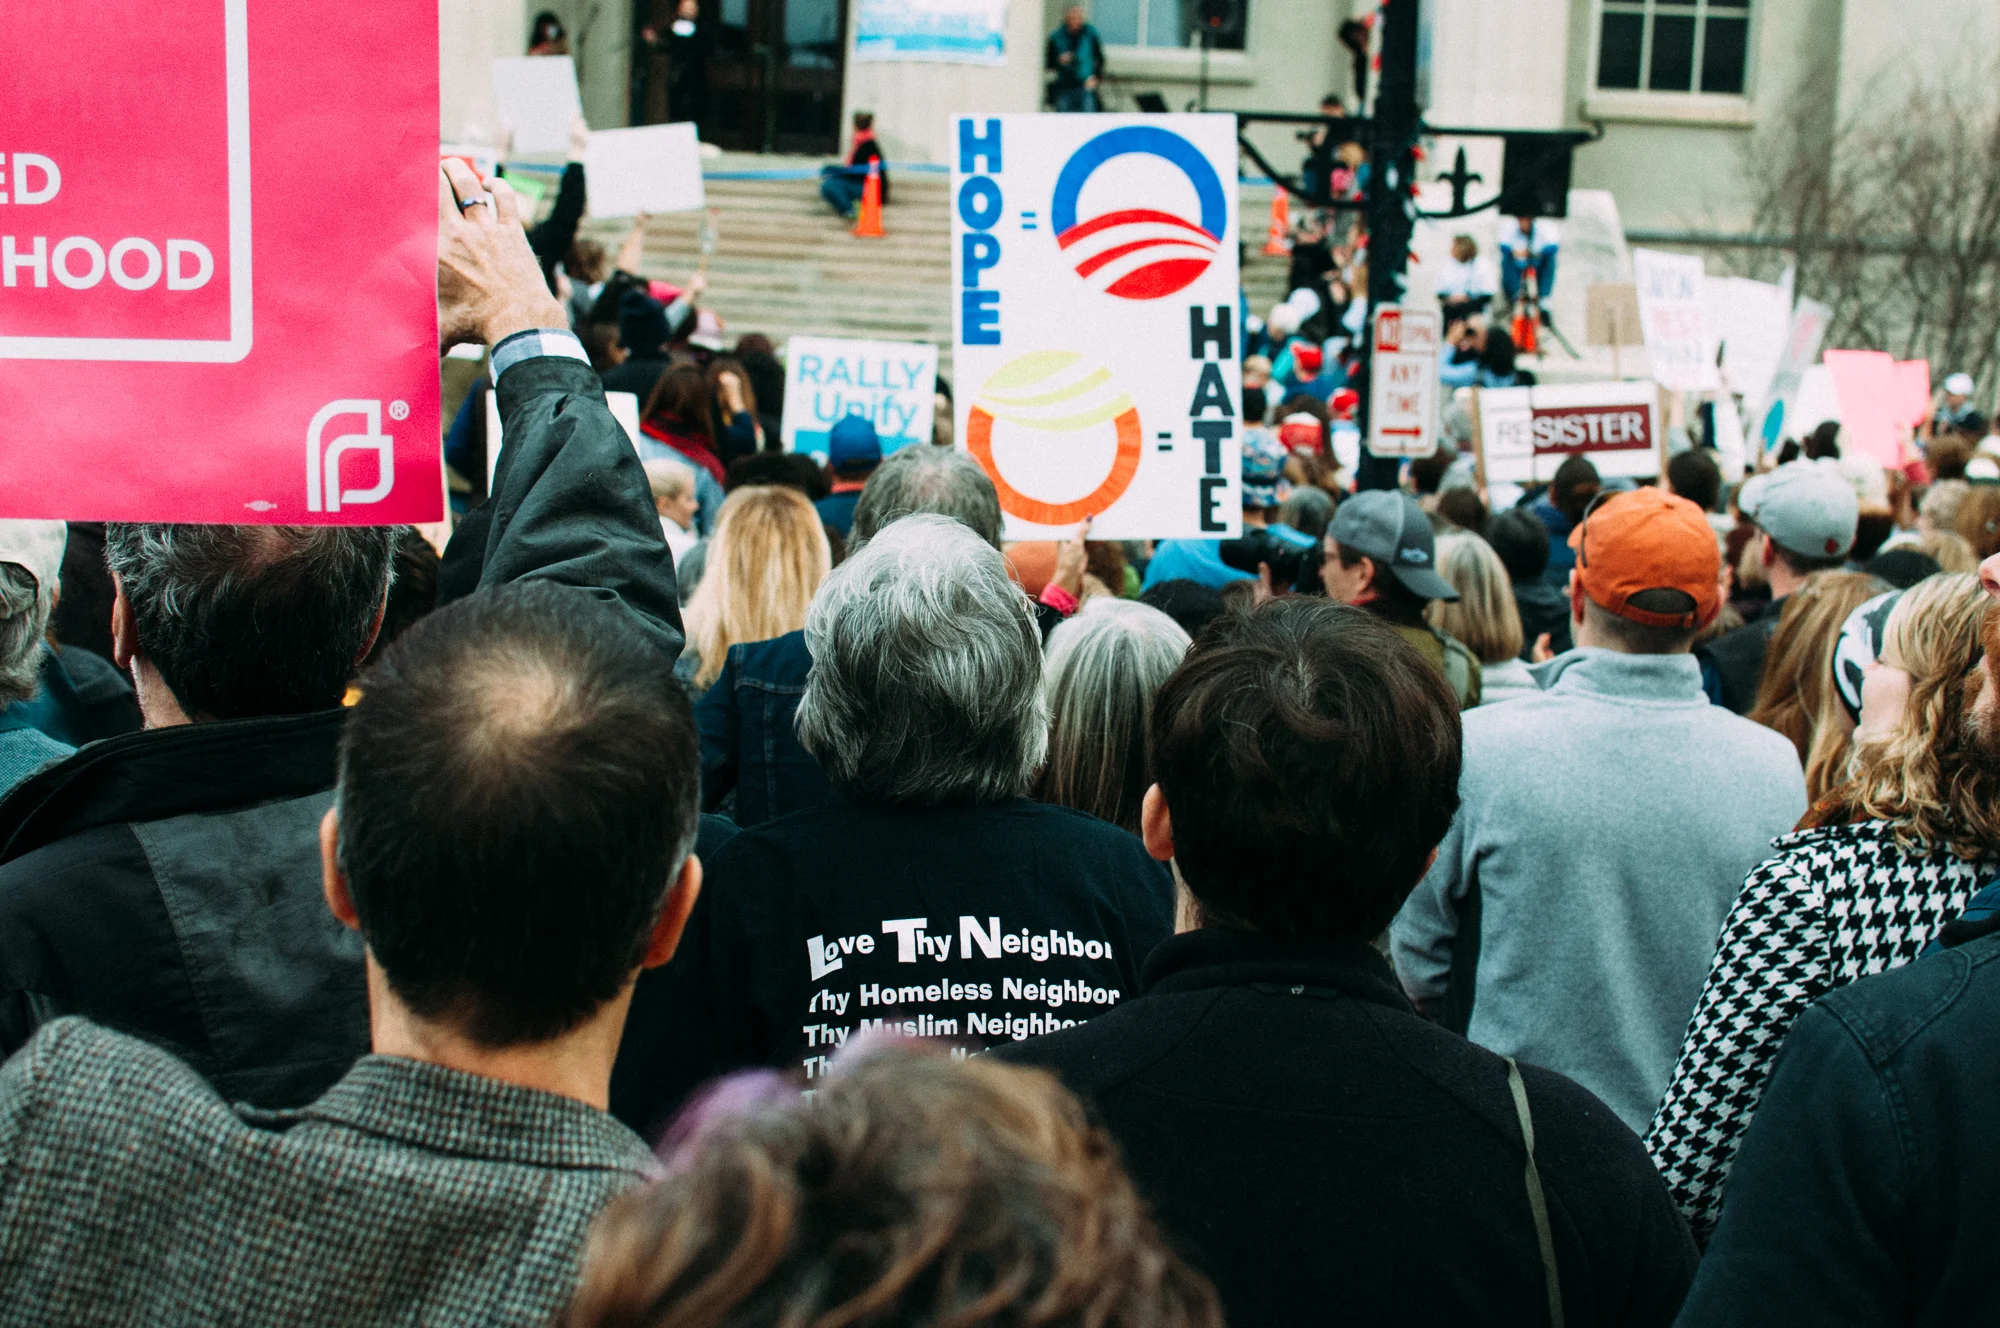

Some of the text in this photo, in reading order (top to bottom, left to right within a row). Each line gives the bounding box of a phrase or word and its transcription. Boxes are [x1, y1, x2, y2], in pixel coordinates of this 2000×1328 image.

[959, 118, 1002, 345] HOPE
[799, 355, 926, 390] RALLY
[1390, 364, 1421, 384] ANY
[814, 391, 918, 437] Unify
[1189, 305, 1235, 532] HATE
[806, 934, 875, 982] Love
[881, 917, 952, 963] Thy
[860, 978, 993, 1007] Homeless
[1002, 977, 1121, 1008] Neighbor
[803, 1023, 850, 1048] Thy
